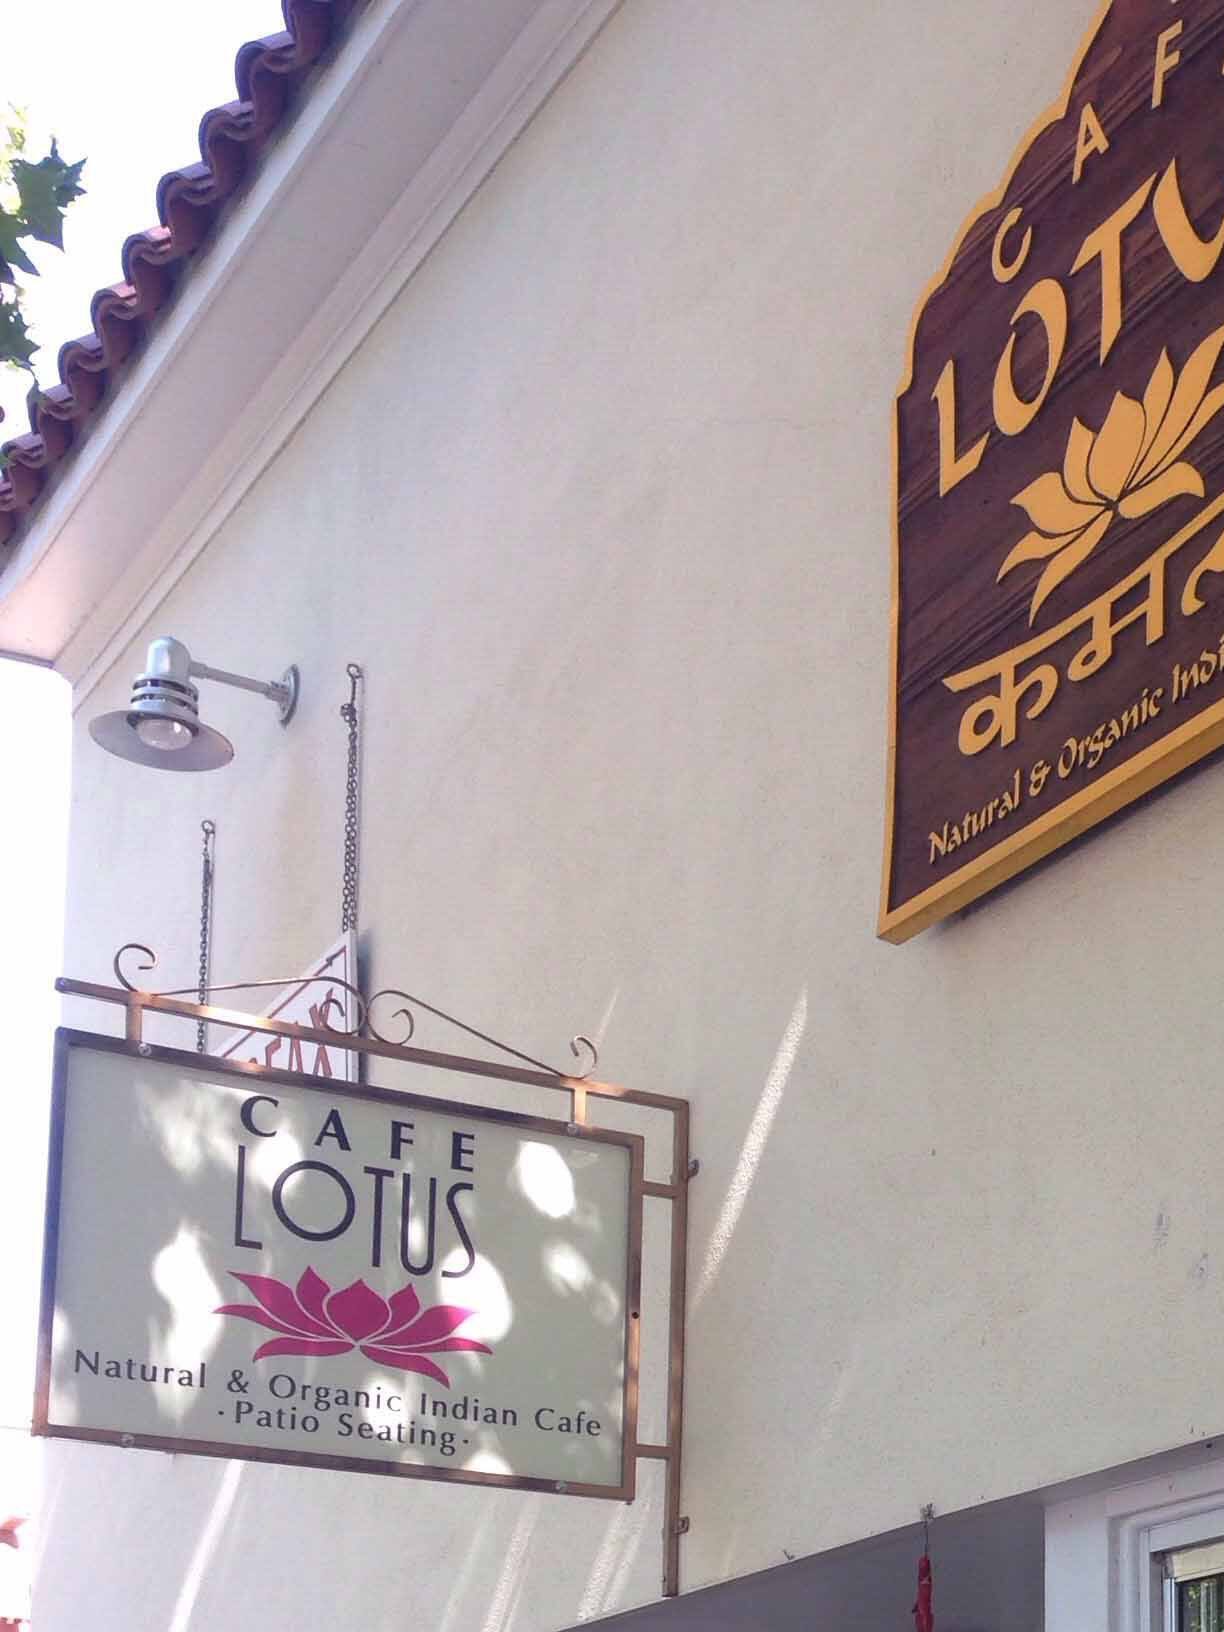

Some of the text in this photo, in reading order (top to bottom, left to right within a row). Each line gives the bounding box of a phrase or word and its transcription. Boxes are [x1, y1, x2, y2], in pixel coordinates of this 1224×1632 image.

[928, 770, 1021, 864] Natural
[1029, 760, 1051, 798] &
[1057, 687, 1164, 769] Organic
[240, 1095, 476, 1172] CAFE
[234, 1144, 476, 1279] LOTUS
[74, 1349, 601, 1436] Natural & Organic Indian Cafe
[235, 1400, 456, 1456] Patio Seating
